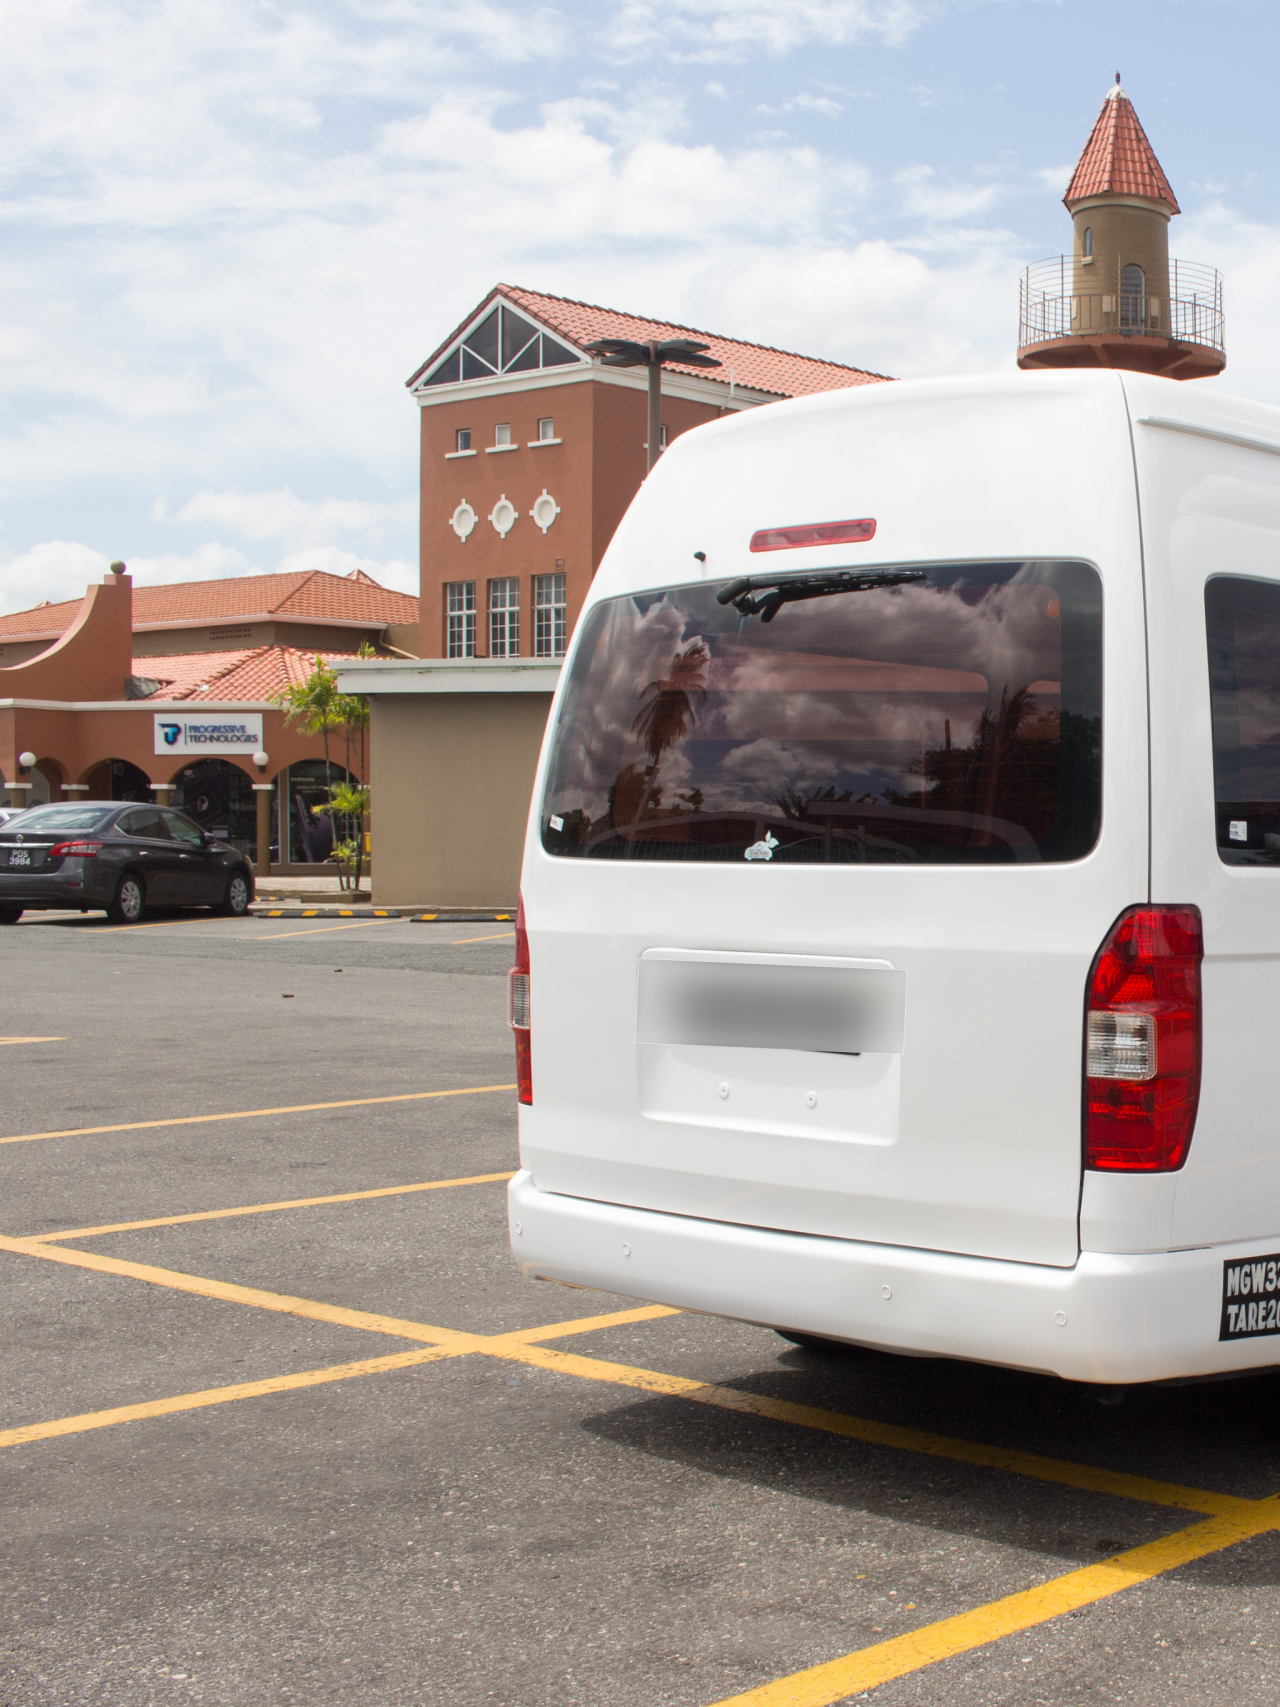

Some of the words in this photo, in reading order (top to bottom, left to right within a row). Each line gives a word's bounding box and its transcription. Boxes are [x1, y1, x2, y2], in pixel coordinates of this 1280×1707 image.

[188, 725, 247, 734] PROGRESSIVE
[188, 734, 259, 743] TECHNOLOGIES
[11, 849, 29, 858] PDS
[9, 857, 31, 866] 3984
